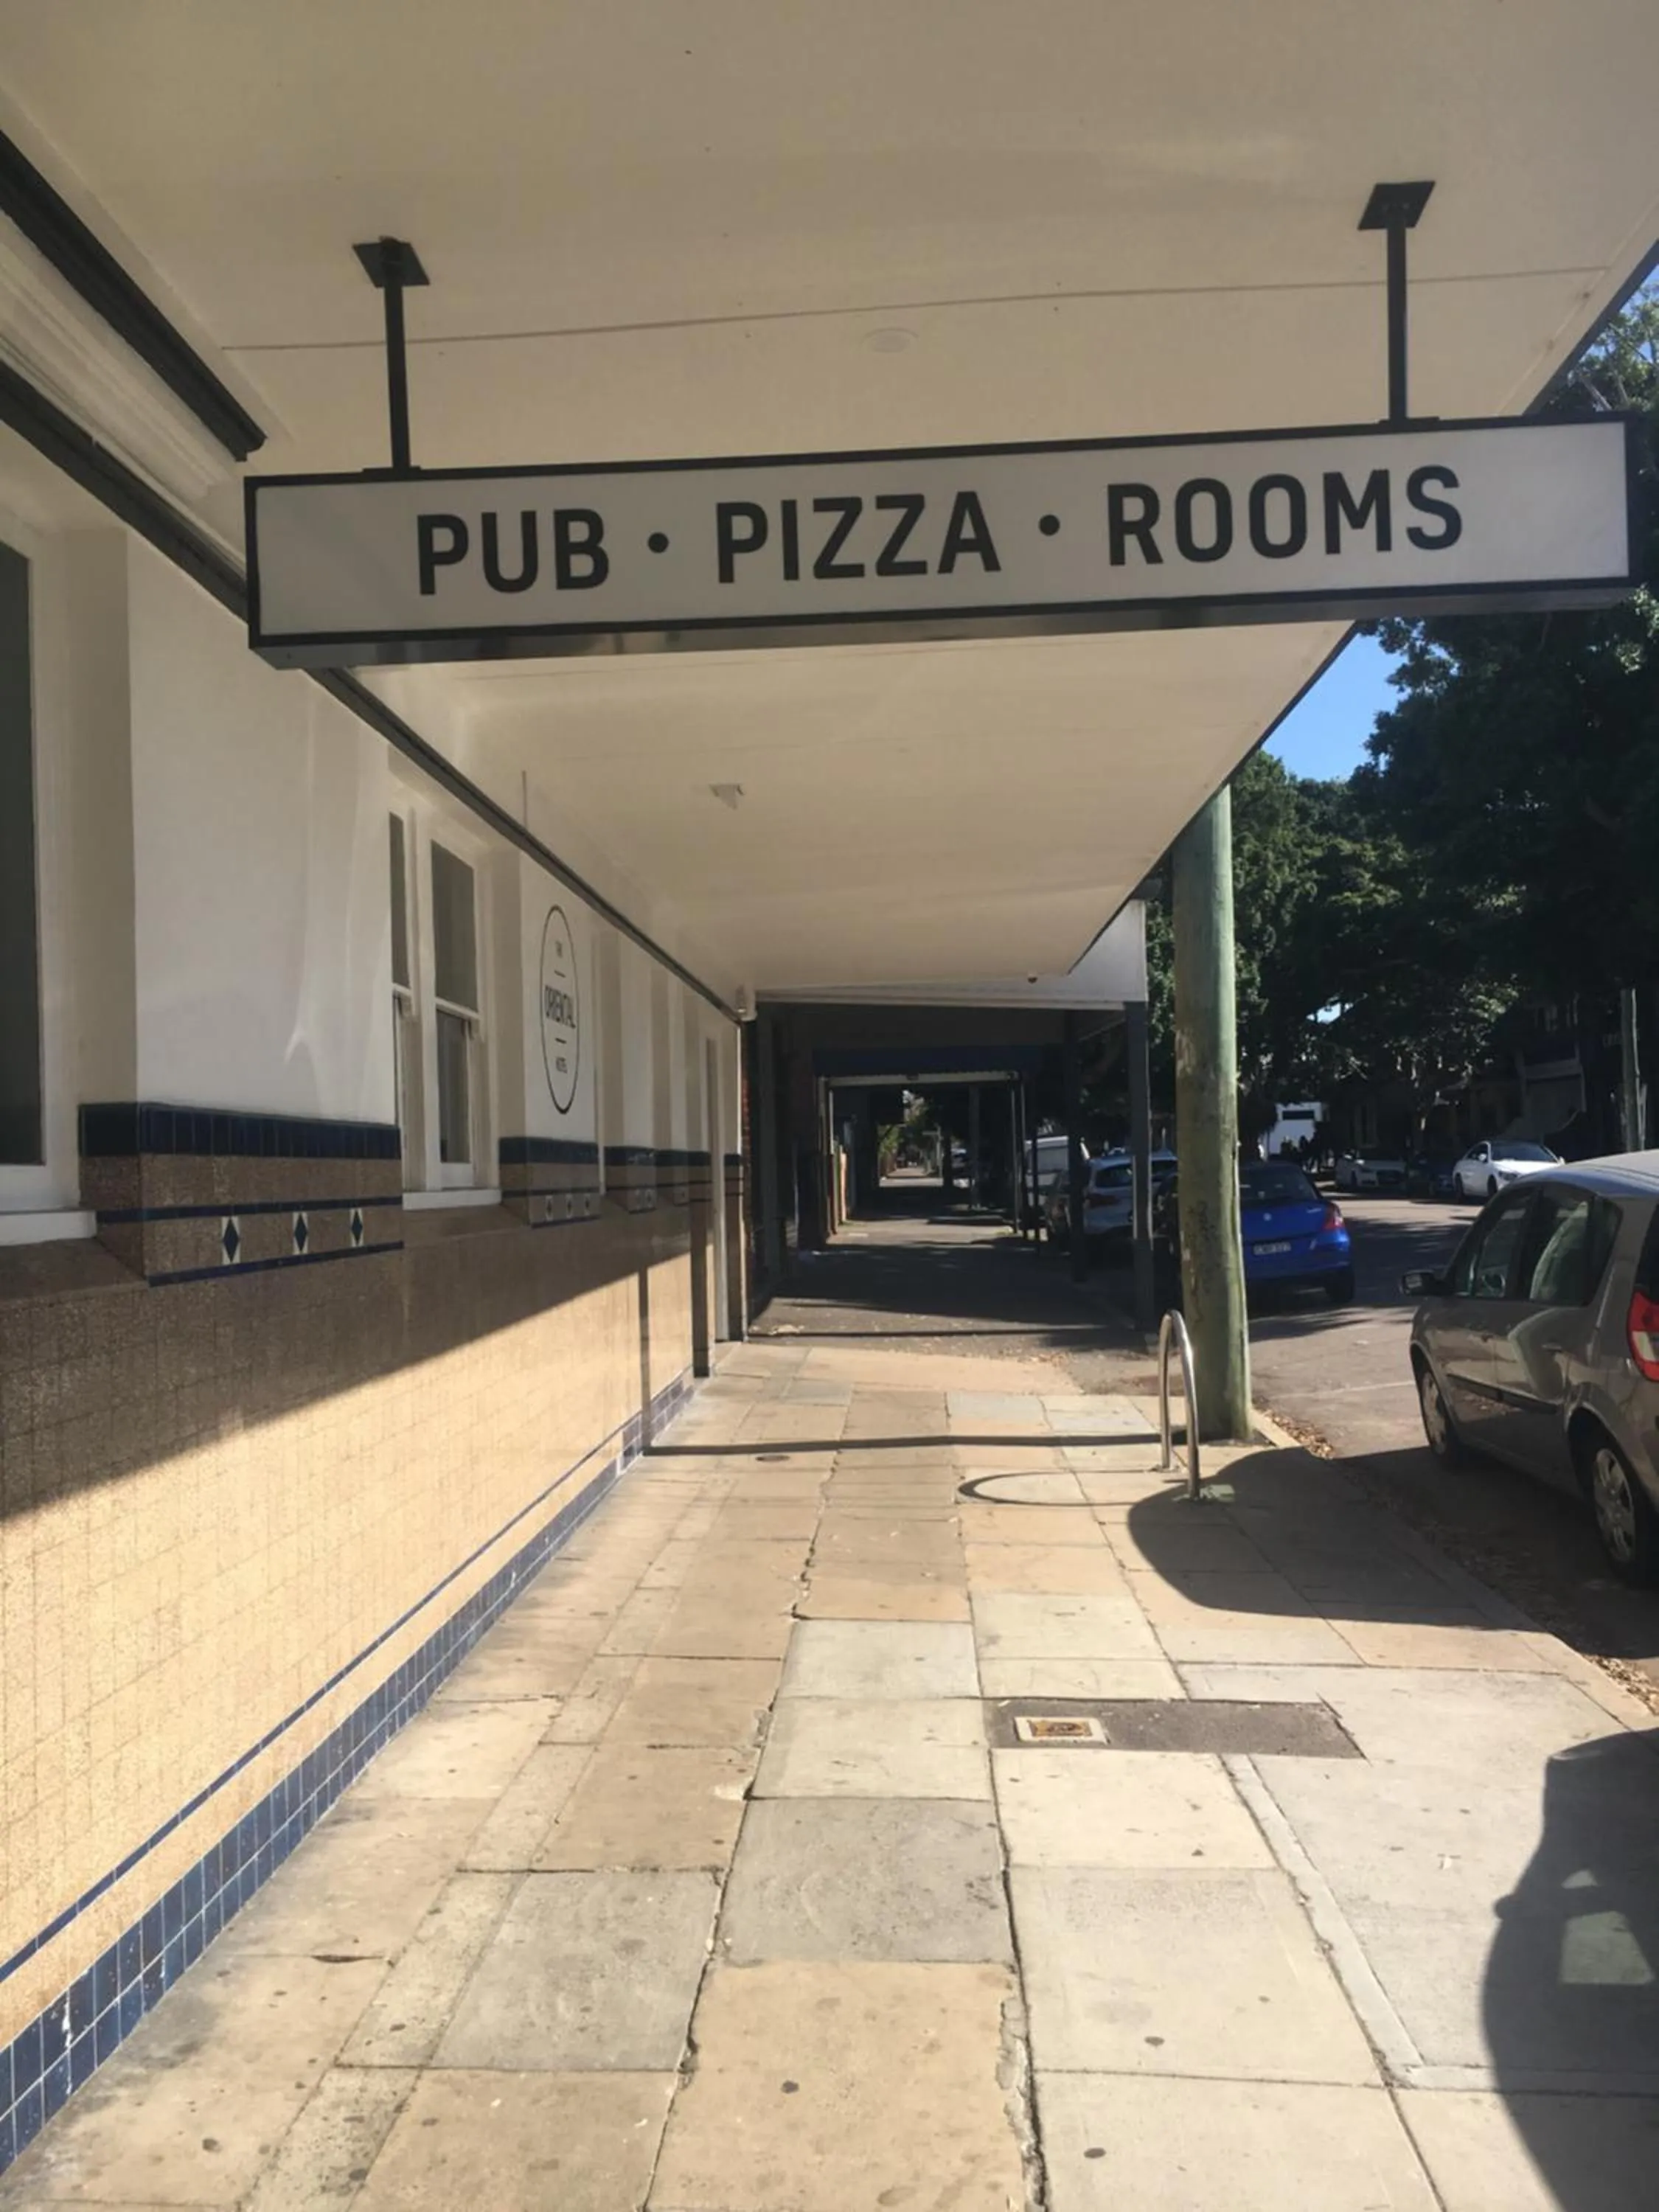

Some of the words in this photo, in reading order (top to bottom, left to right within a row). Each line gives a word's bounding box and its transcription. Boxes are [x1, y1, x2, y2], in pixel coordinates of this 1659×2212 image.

[417, 508, 609, 596] PUB
[716, 490, 1001, 584] PIZZA
[1107, 465, 1462, 567] ROOMS
